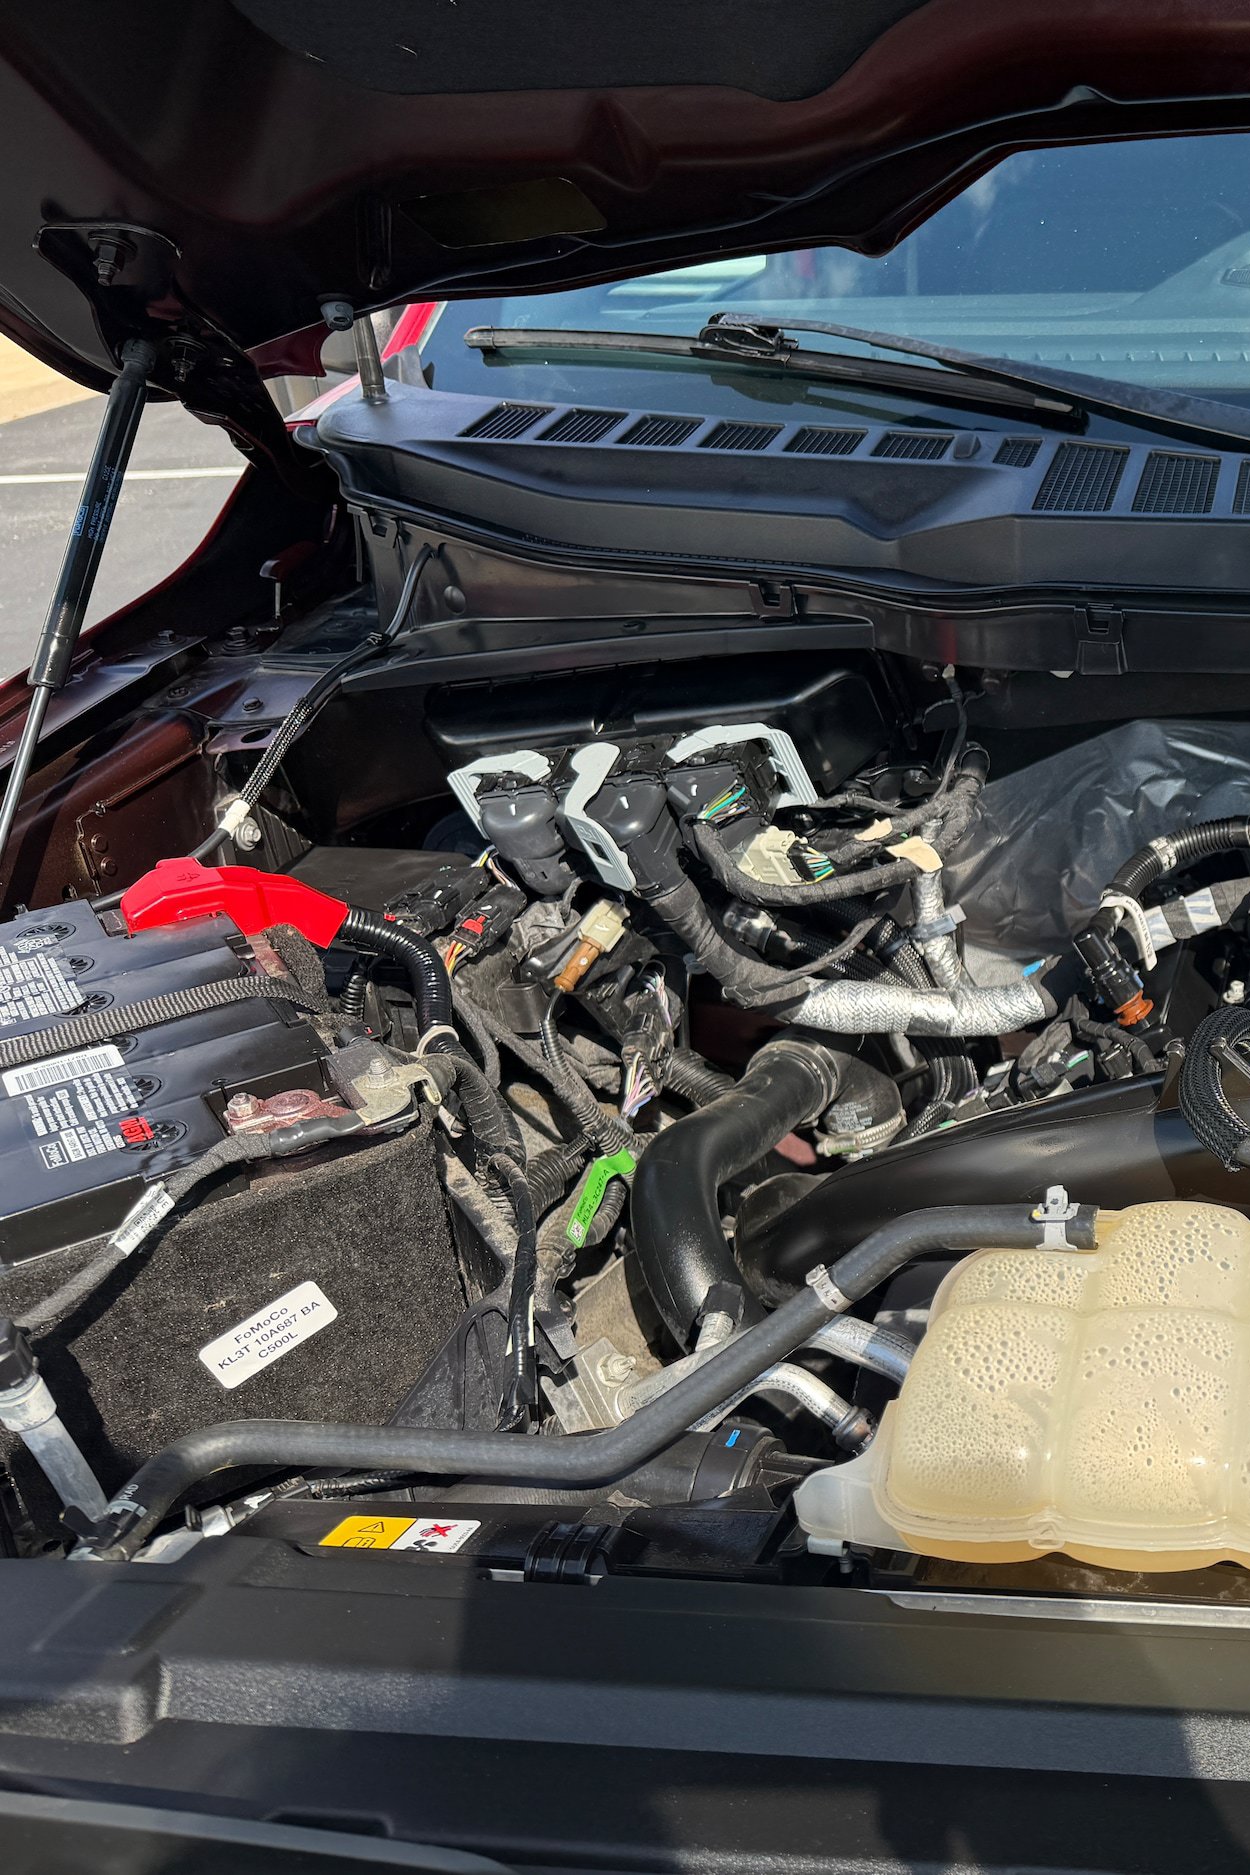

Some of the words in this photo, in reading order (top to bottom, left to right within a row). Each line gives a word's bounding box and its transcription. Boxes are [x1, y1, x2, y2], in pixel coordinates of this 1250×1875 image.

[119, 1117, 147, 1143] AGM
[218, 1344, 252, 1370] KL3T
[254, 1313, 298, 1346] 10A687
[300, 1301, 321, 1316] BA
[234, 1307, 288, 1344] FoMoCo
[258, 1332, 299, 1359] C500L
[124, 1483, 140, 1501] RAD
